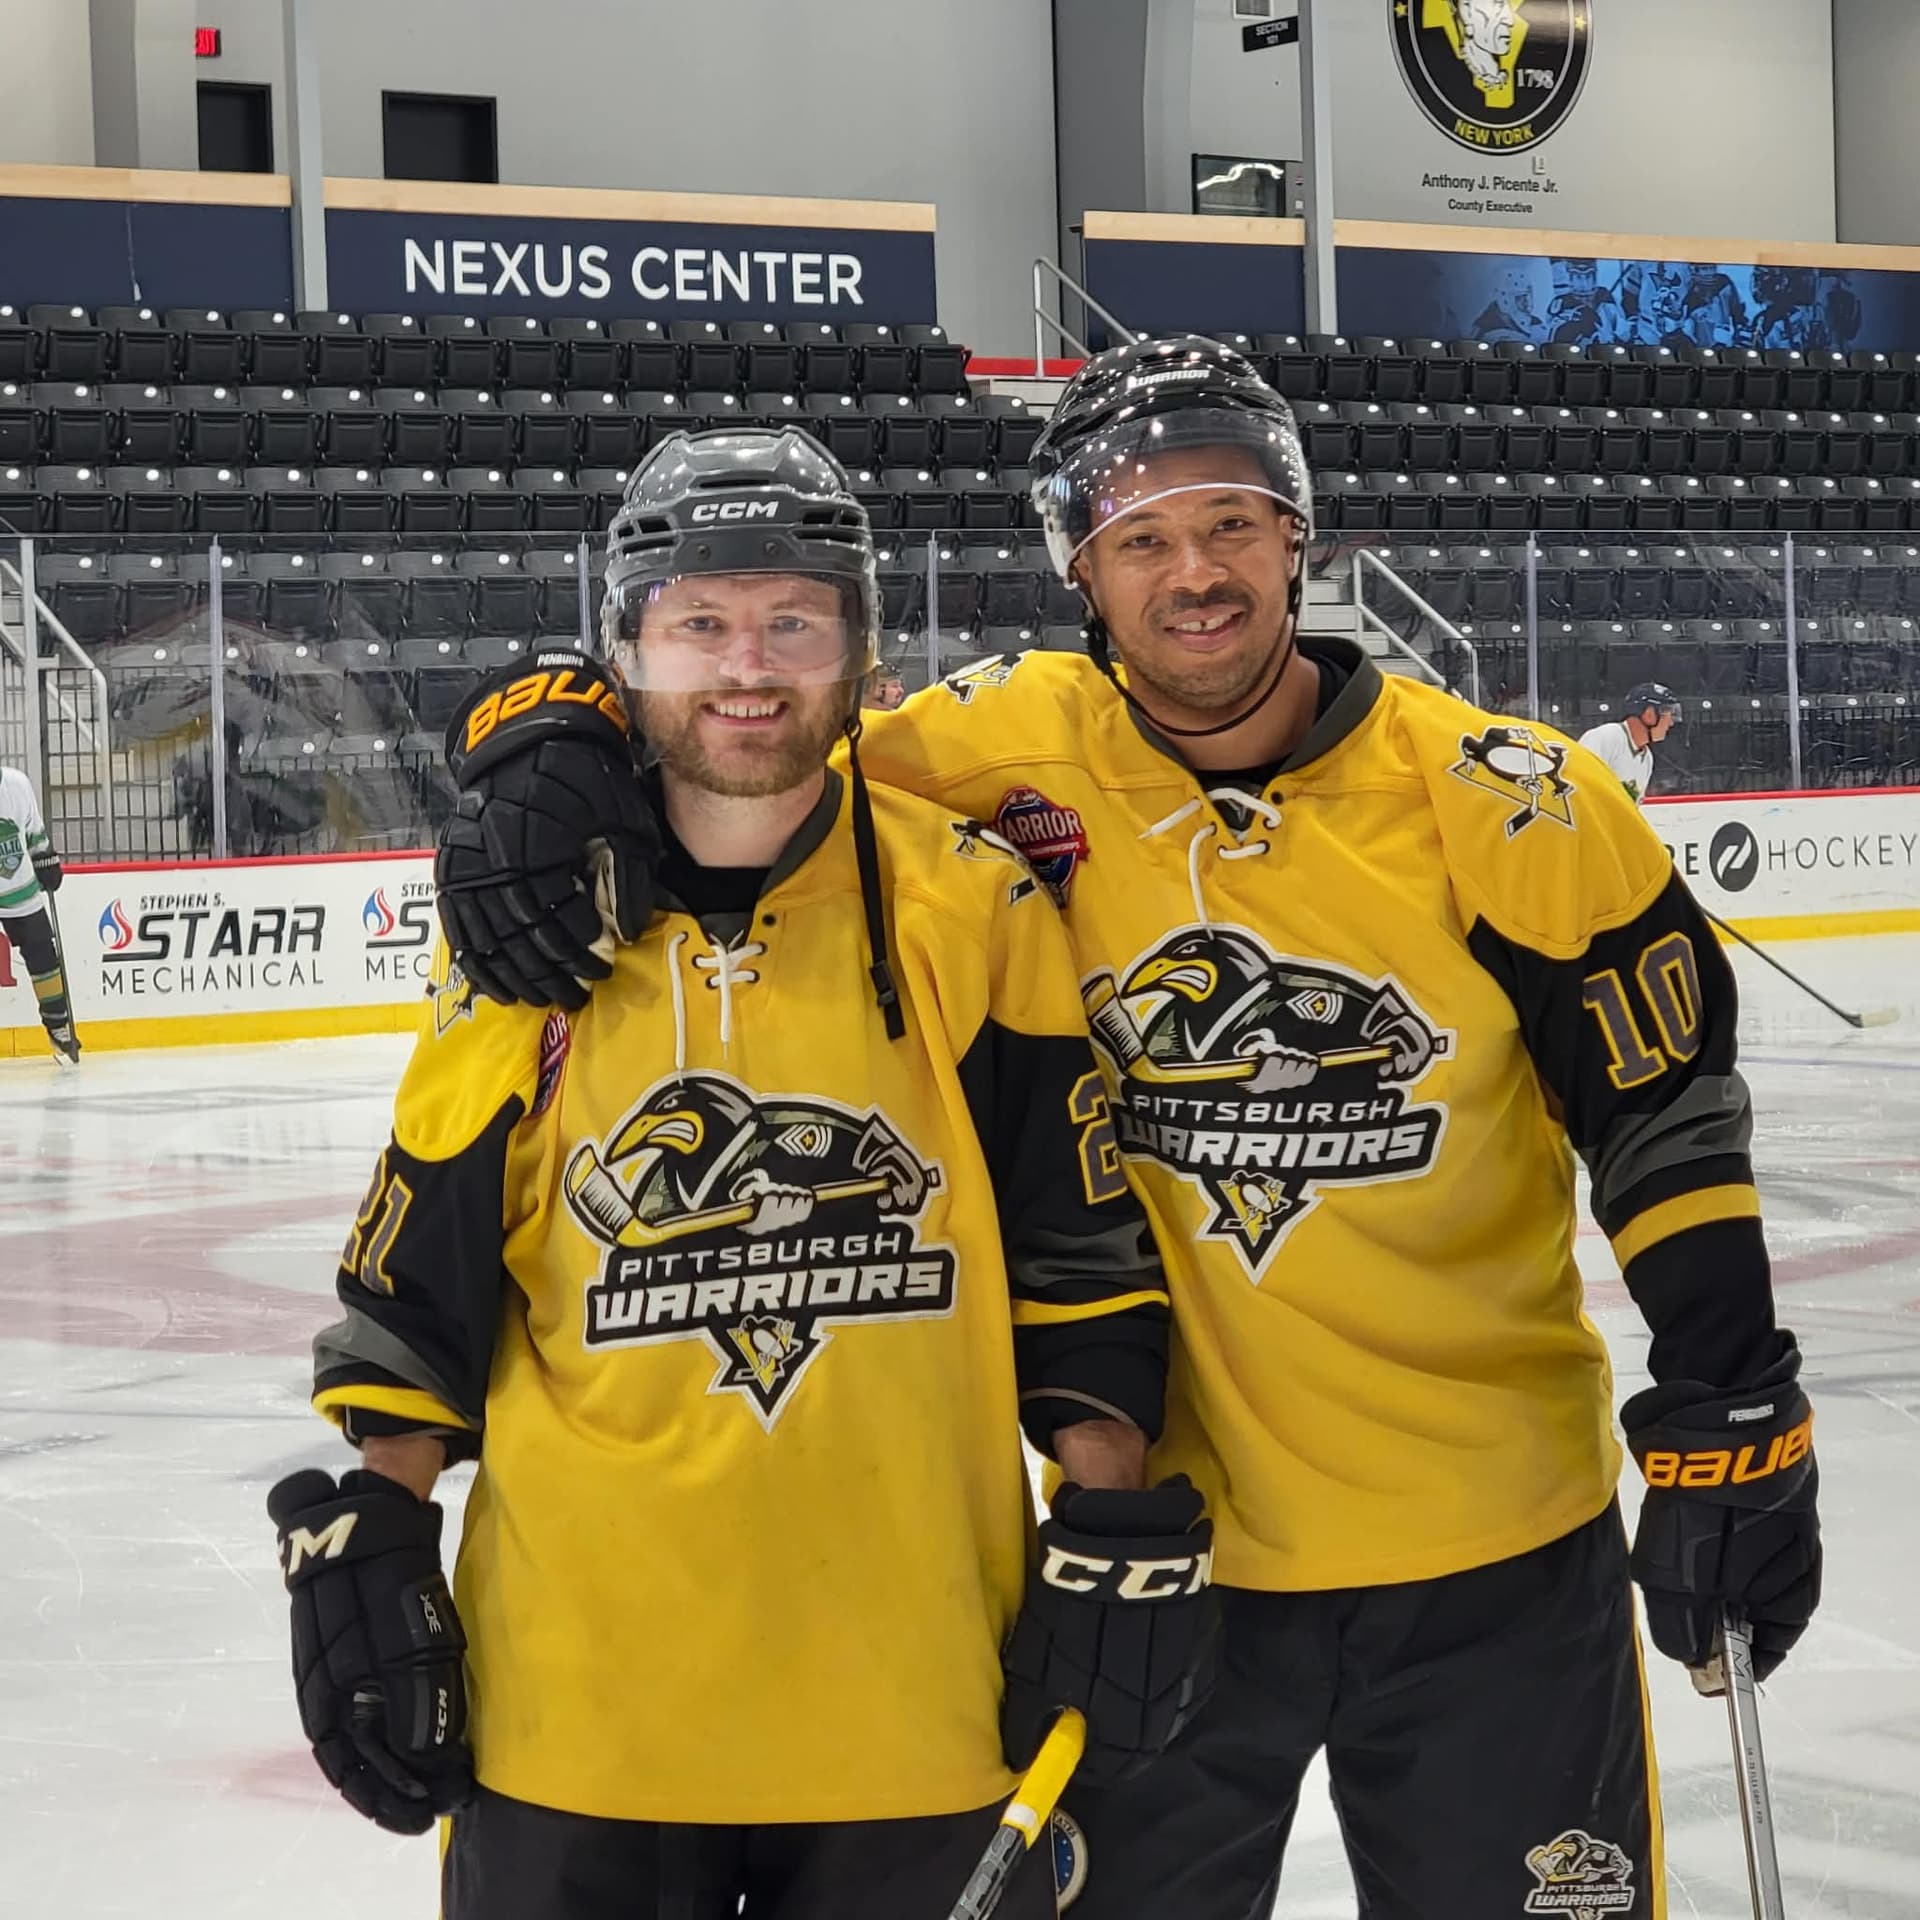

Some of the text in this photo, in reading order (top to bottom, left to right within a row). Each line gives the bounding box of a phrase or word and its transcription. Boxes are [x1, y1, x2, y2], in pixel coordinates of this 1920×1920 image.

[1516, 68, 1554, 89] 1798
[1454, 119, 1534, 145] NEW YORK
[1422, 173, 1558, 193] Anthony J. Picente Jr.
[1448, 198, 1533, 214] County Executive
[404, 238, 864, 305] NEXUS CENTER
[692, 501, 779, 522] CCM
[1768, 833, 1918, 871] HOCKEY
[140, 893, 225, 911] STEPHEN S.
[102, 905, 326, 962] STARR
[102, 961, 325, 996] MECHANICAL
[1582, 931, 1704, 1089] 10
[1132, 1095, 1394, 1124] PITTSBURGH
[1118, 1114, 1428, 1169] WARRIORS
[619, 1231, 901, 1284] PITTSBURGH
[594, 1260, 944, 1331] WARRIORS
[434, 1688, 448, 1745] CCM
[1533, 1893, 1630, 1906] WARRIORS
[1546, 1884, 1621, 1894] PITTSBURGH
